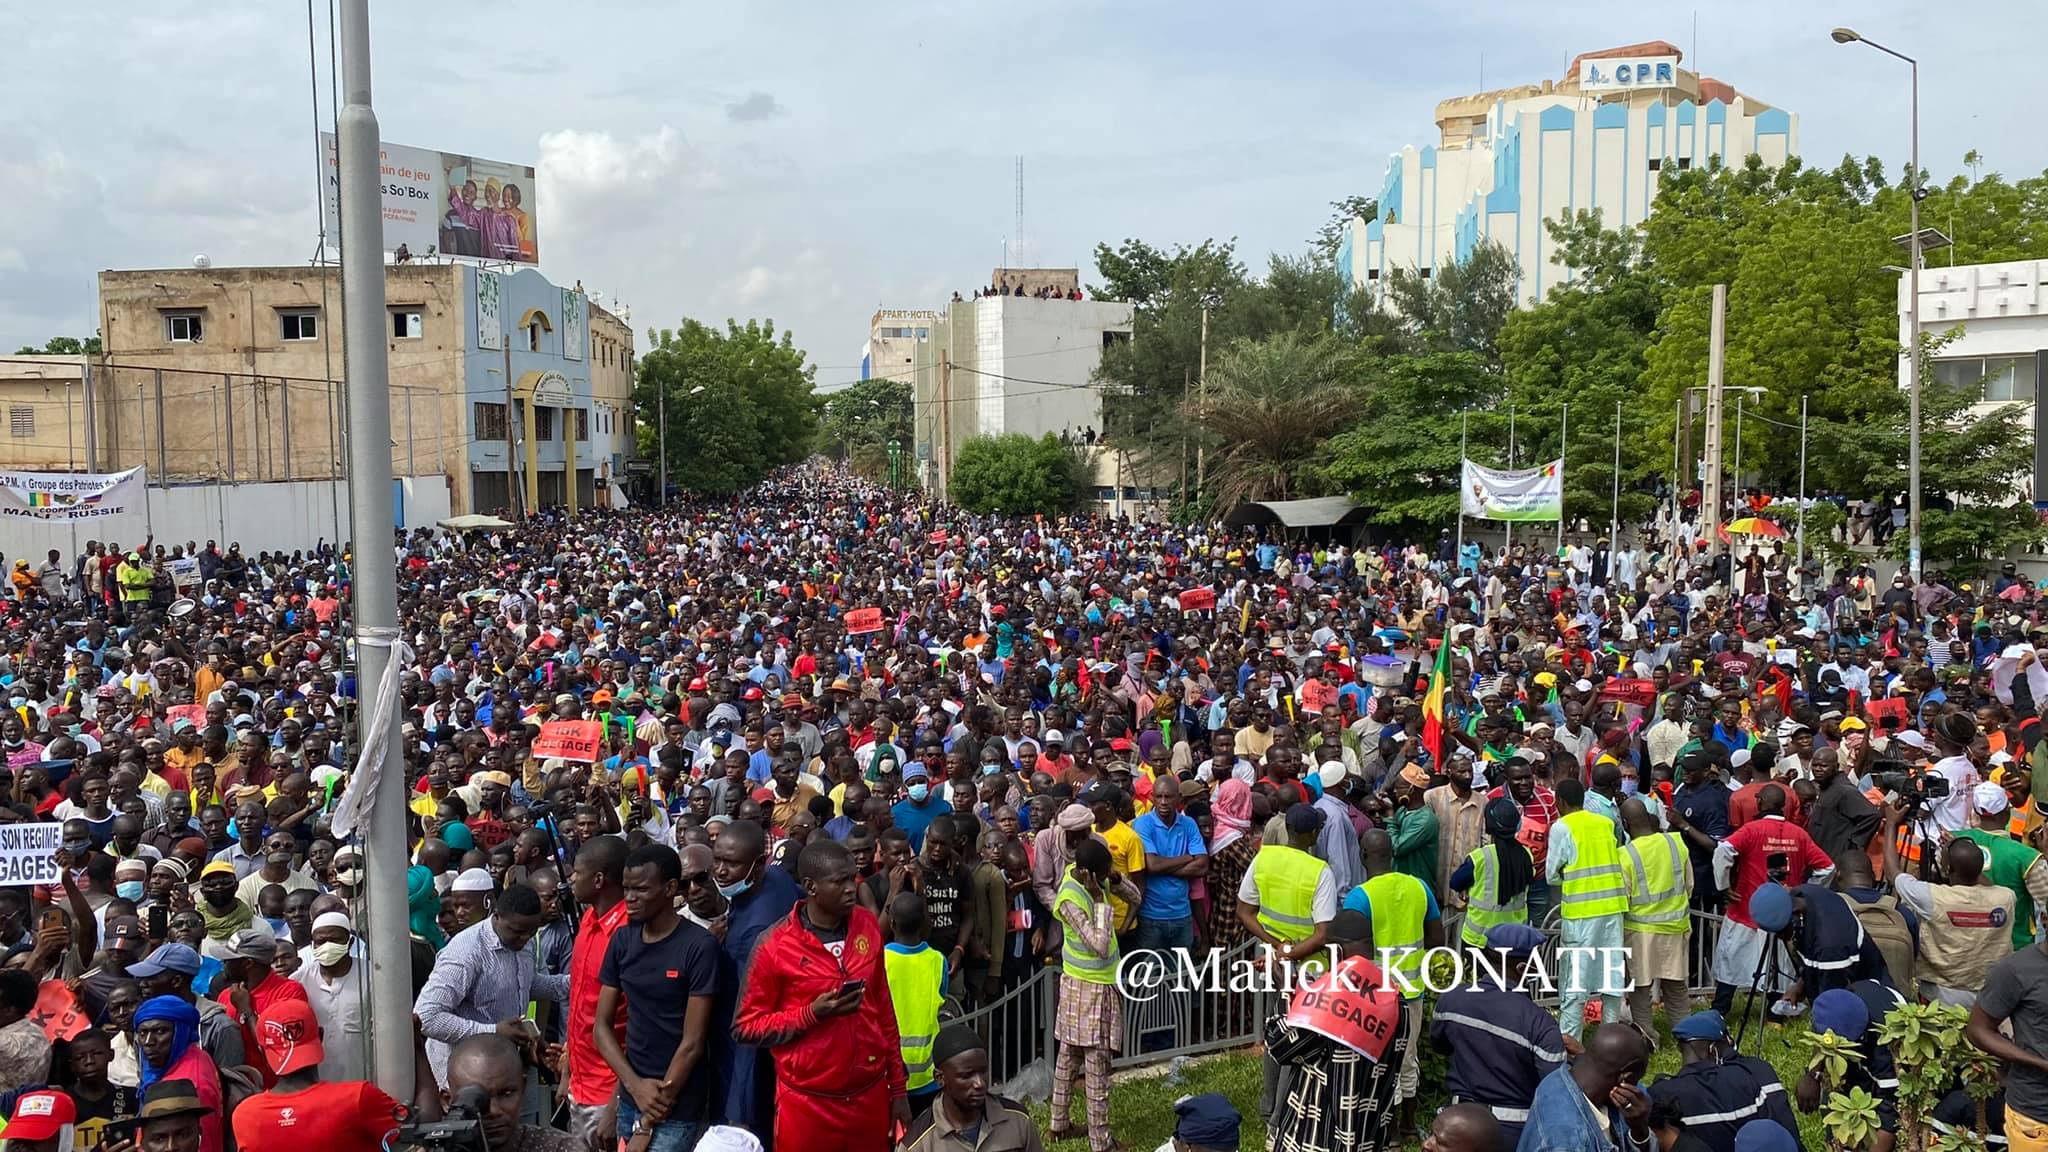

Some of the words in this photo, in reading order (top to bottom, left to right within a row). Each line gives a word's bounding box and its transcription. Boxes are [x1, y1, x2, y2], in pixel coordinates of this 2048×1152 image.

[1615, 62, 1672, 82] CPR
[398, 167, 412, 178] de
[414, 170, 431, 182] jeu
[28, 478, 57, 491] Groupe
[59, 479, 74, 490] des
[74, 479, 104, 490] Patriotes
[3, 508, 50, 519] MALI
[68, 507, 125, 518] RUSSIE
[1619, 683, 1641, 693] IBK
[555, 726, 581, 737] IBK
[1, 829, 21, 850] SON
[23, 827, 60, 849] REGIME
[1528, 829, 1544, 842] IB
[1345, 970, 1380, 1006] BK
[1301, 991, 1390, 1041] DEGAGE
